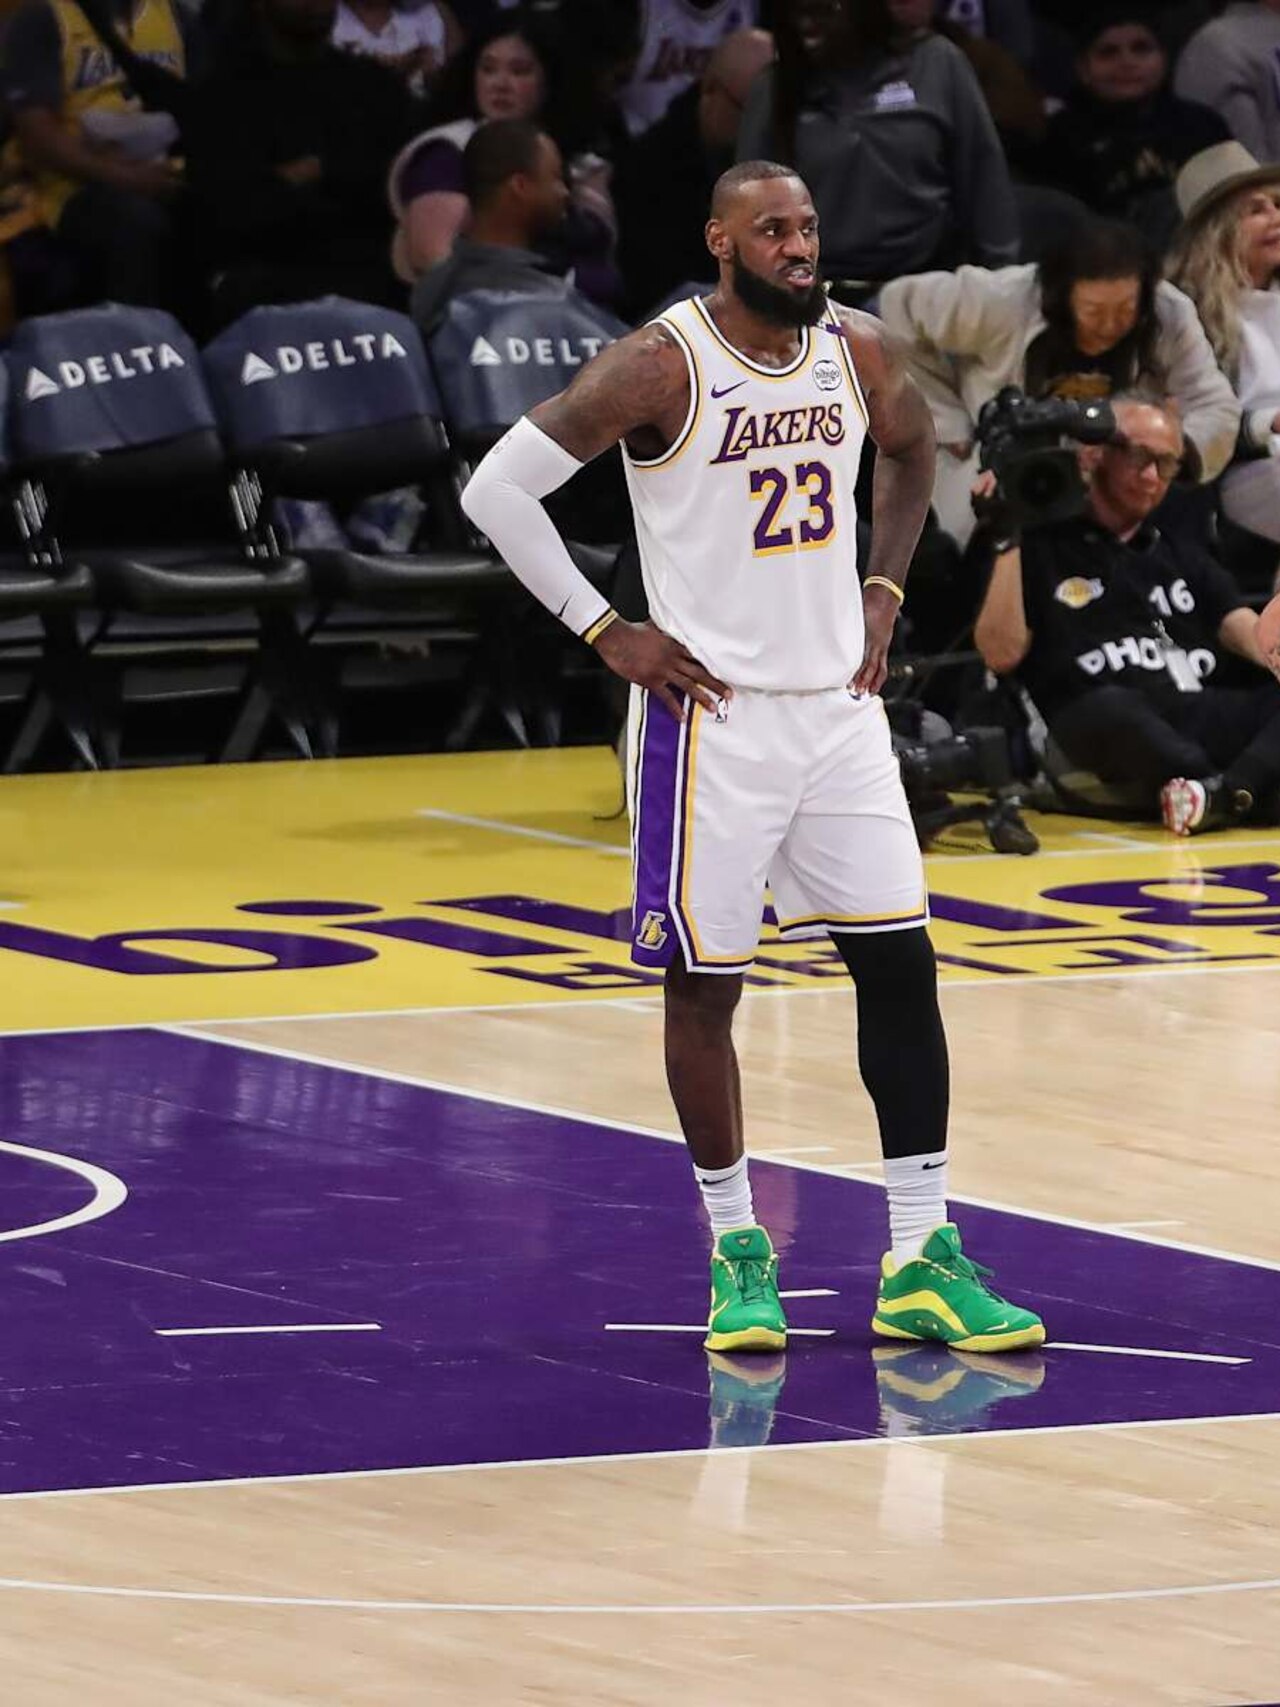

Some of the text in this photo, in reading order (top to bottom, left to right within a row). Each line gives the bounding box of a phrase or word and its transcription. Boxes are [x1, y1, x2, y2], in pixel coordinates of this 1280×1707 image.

[58, 342, 186, 389] DELTA
[276, 331, 408, 375] DELTA
[506, 337, 617, 366] DELT
[708, 402, 847, 466] LAKERS
[749, 460, 837, 559] 23
[1148, 578, 1196, 617] 16
[1077, 636, 1217, 679] PHOO
